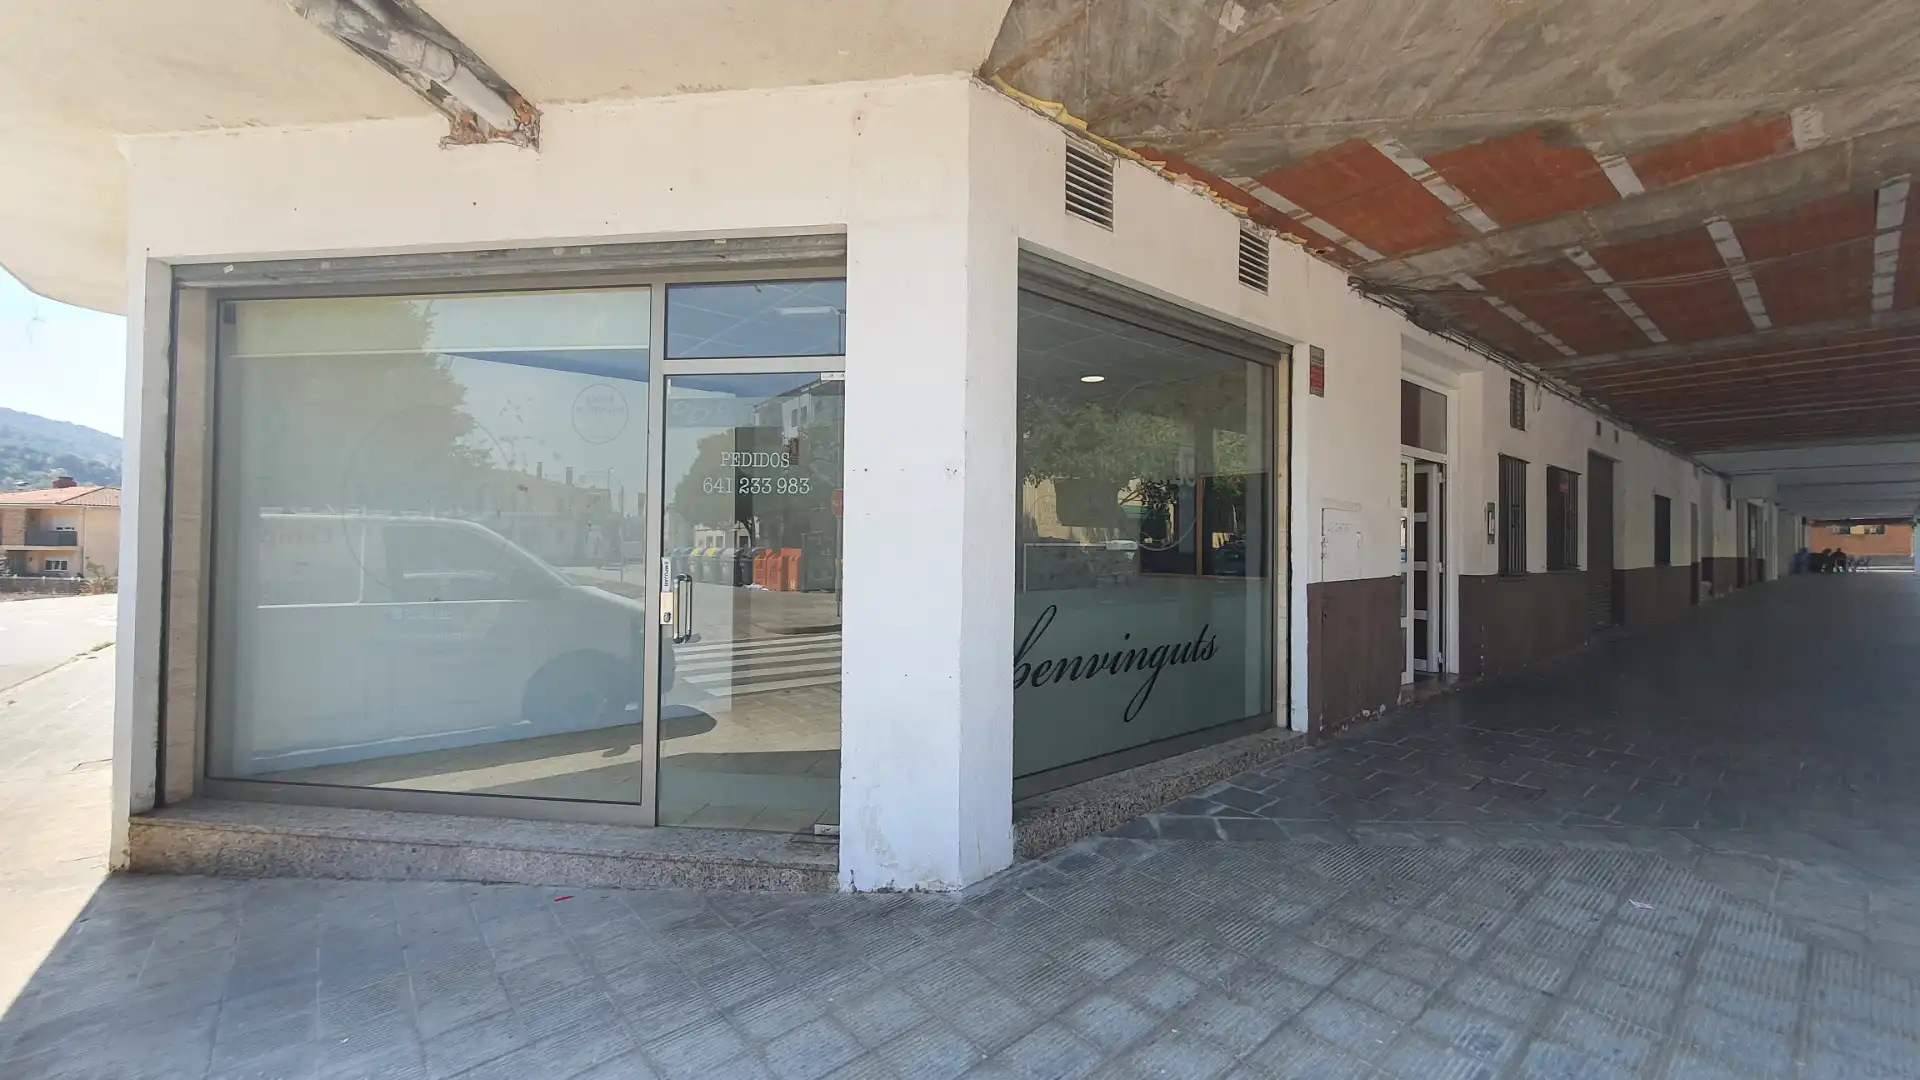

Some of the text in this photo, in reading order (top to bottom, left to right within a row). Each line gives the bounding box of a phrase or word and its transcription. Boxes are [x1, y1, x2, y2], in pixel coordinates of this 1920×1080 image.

[720, 452, 790, 468] PEDIDOS
[703, 477, 810, 494] 641 233 983
[1014, 605, 1218, 723] benvinguts
